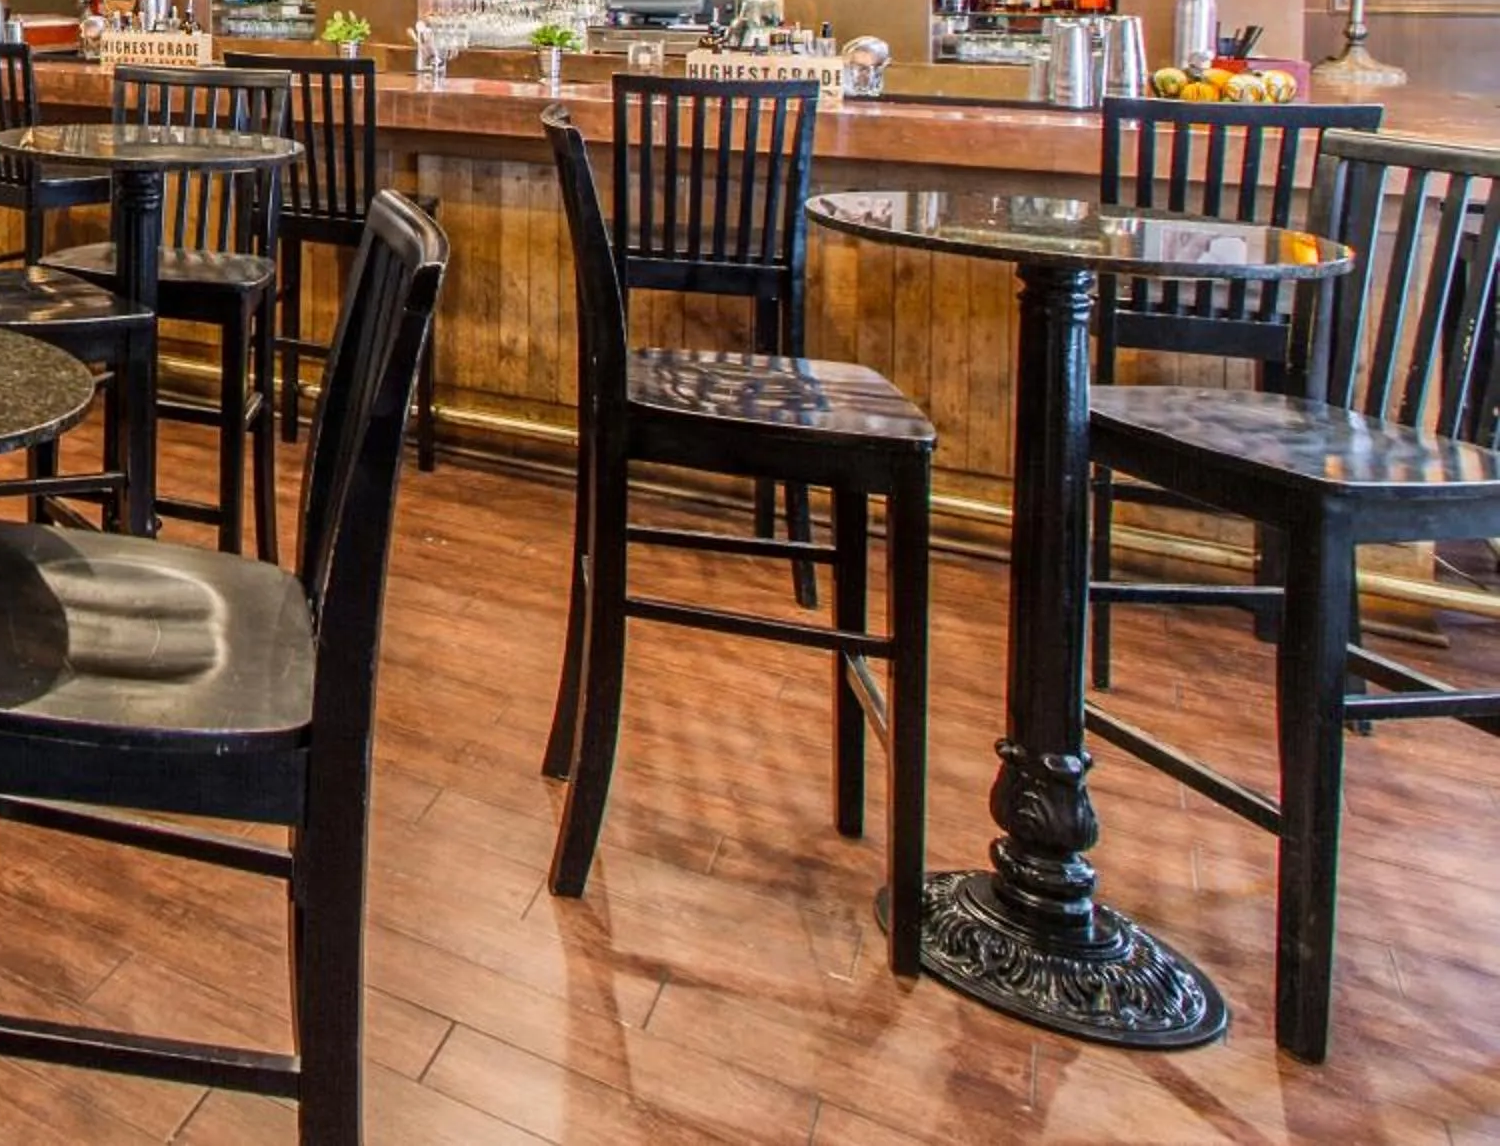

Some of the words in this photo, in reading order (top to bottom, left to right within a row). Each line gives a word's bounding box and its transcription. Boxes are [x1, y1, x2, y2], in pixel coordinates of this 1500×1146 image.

[101, 40, 154, 55] HIGHEST
[157, 41, 198, 56] GRADE
[689, 63, 771, 80] HIGHEST
